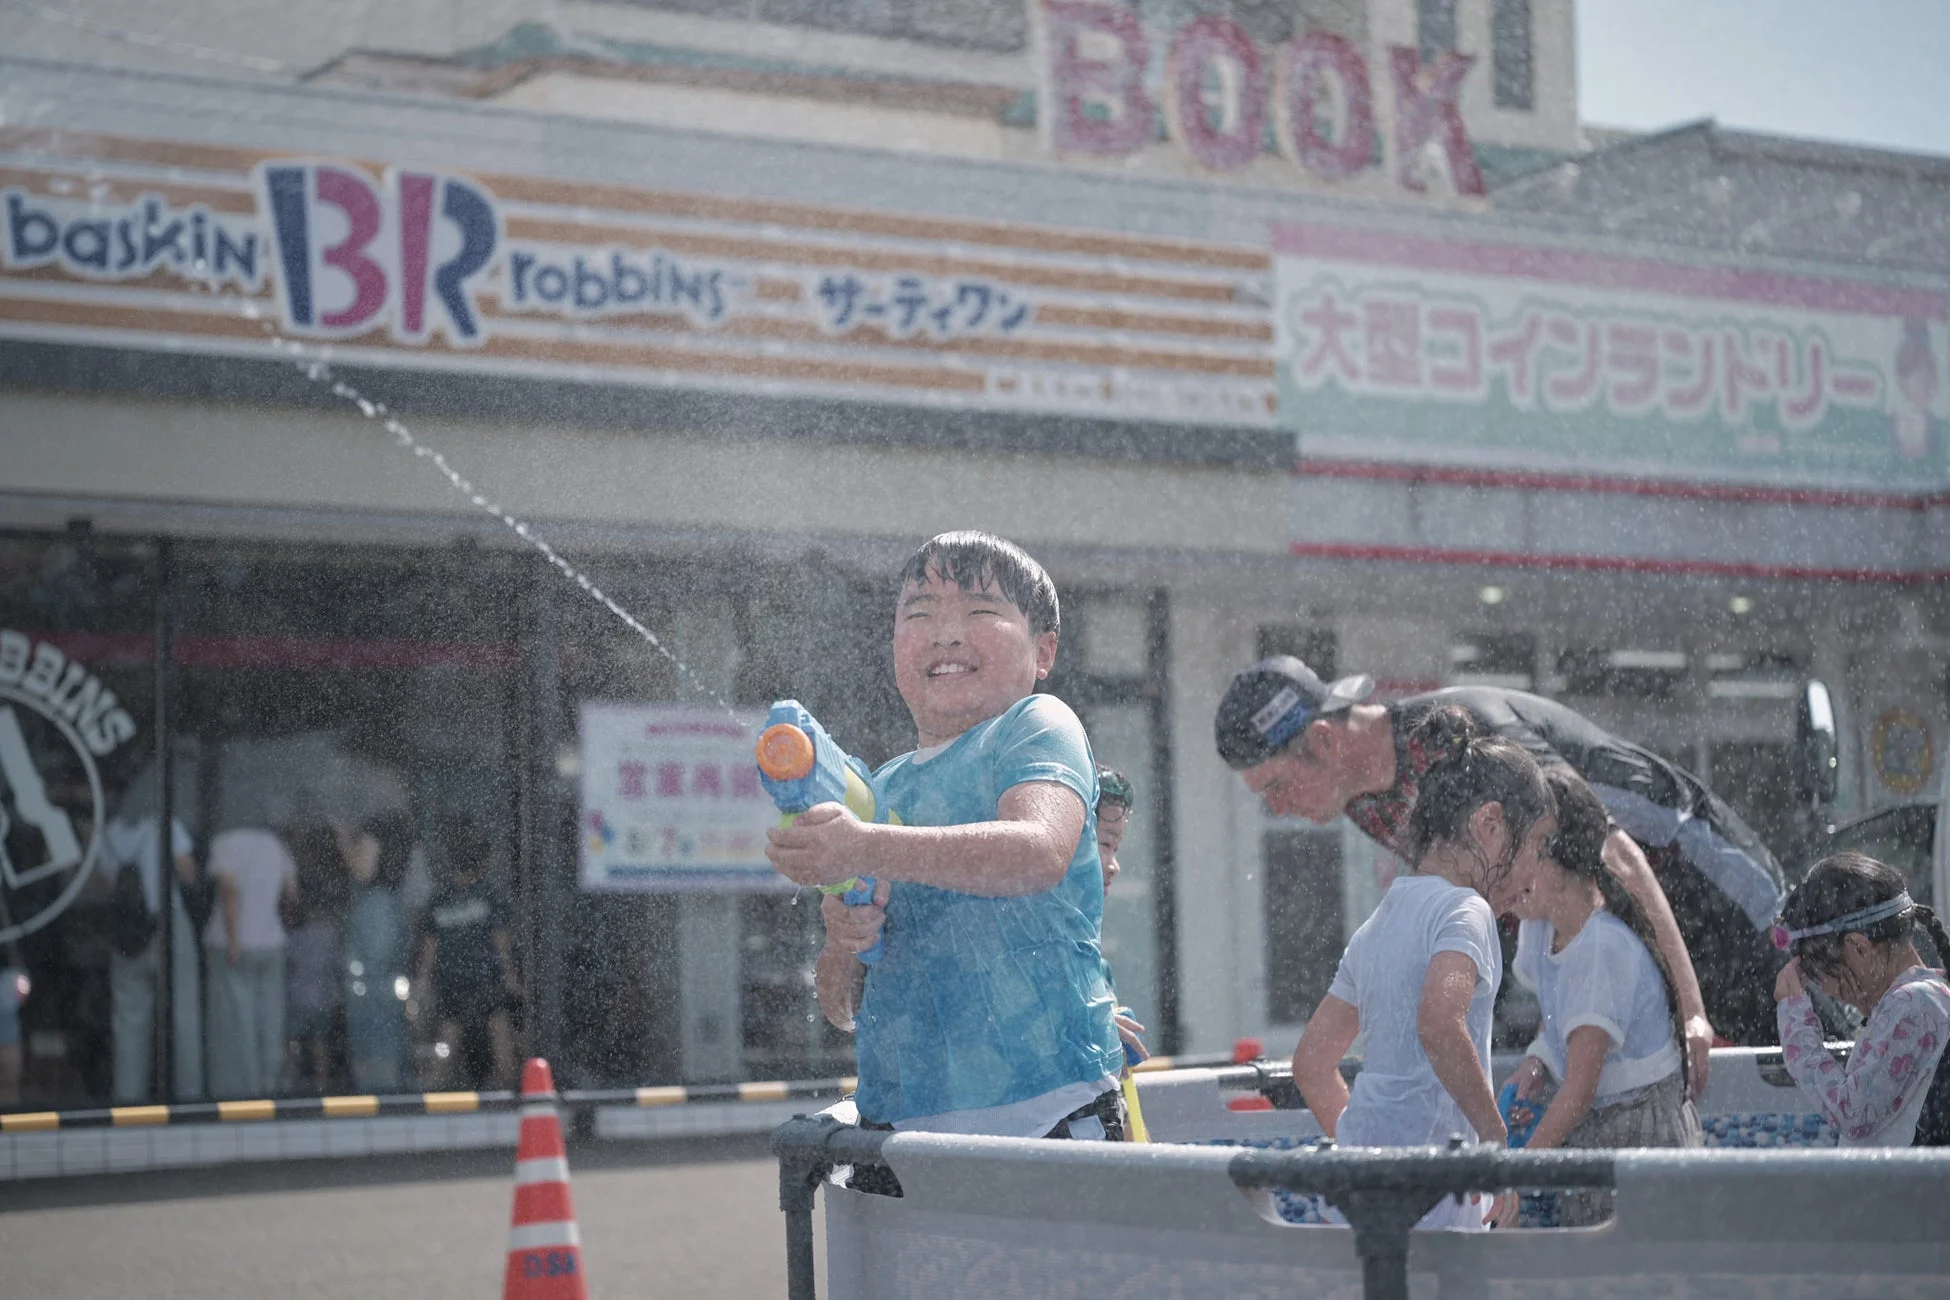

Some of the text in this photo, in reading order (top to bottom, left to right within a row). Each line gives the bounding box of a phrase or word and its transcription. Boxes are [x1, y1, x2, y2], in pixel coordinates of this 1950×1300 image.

[1043, 0, 1487, 196] BOOK
[266, 166, 497, 337] BR
[818, 275, 1028, 332] サーティワン
